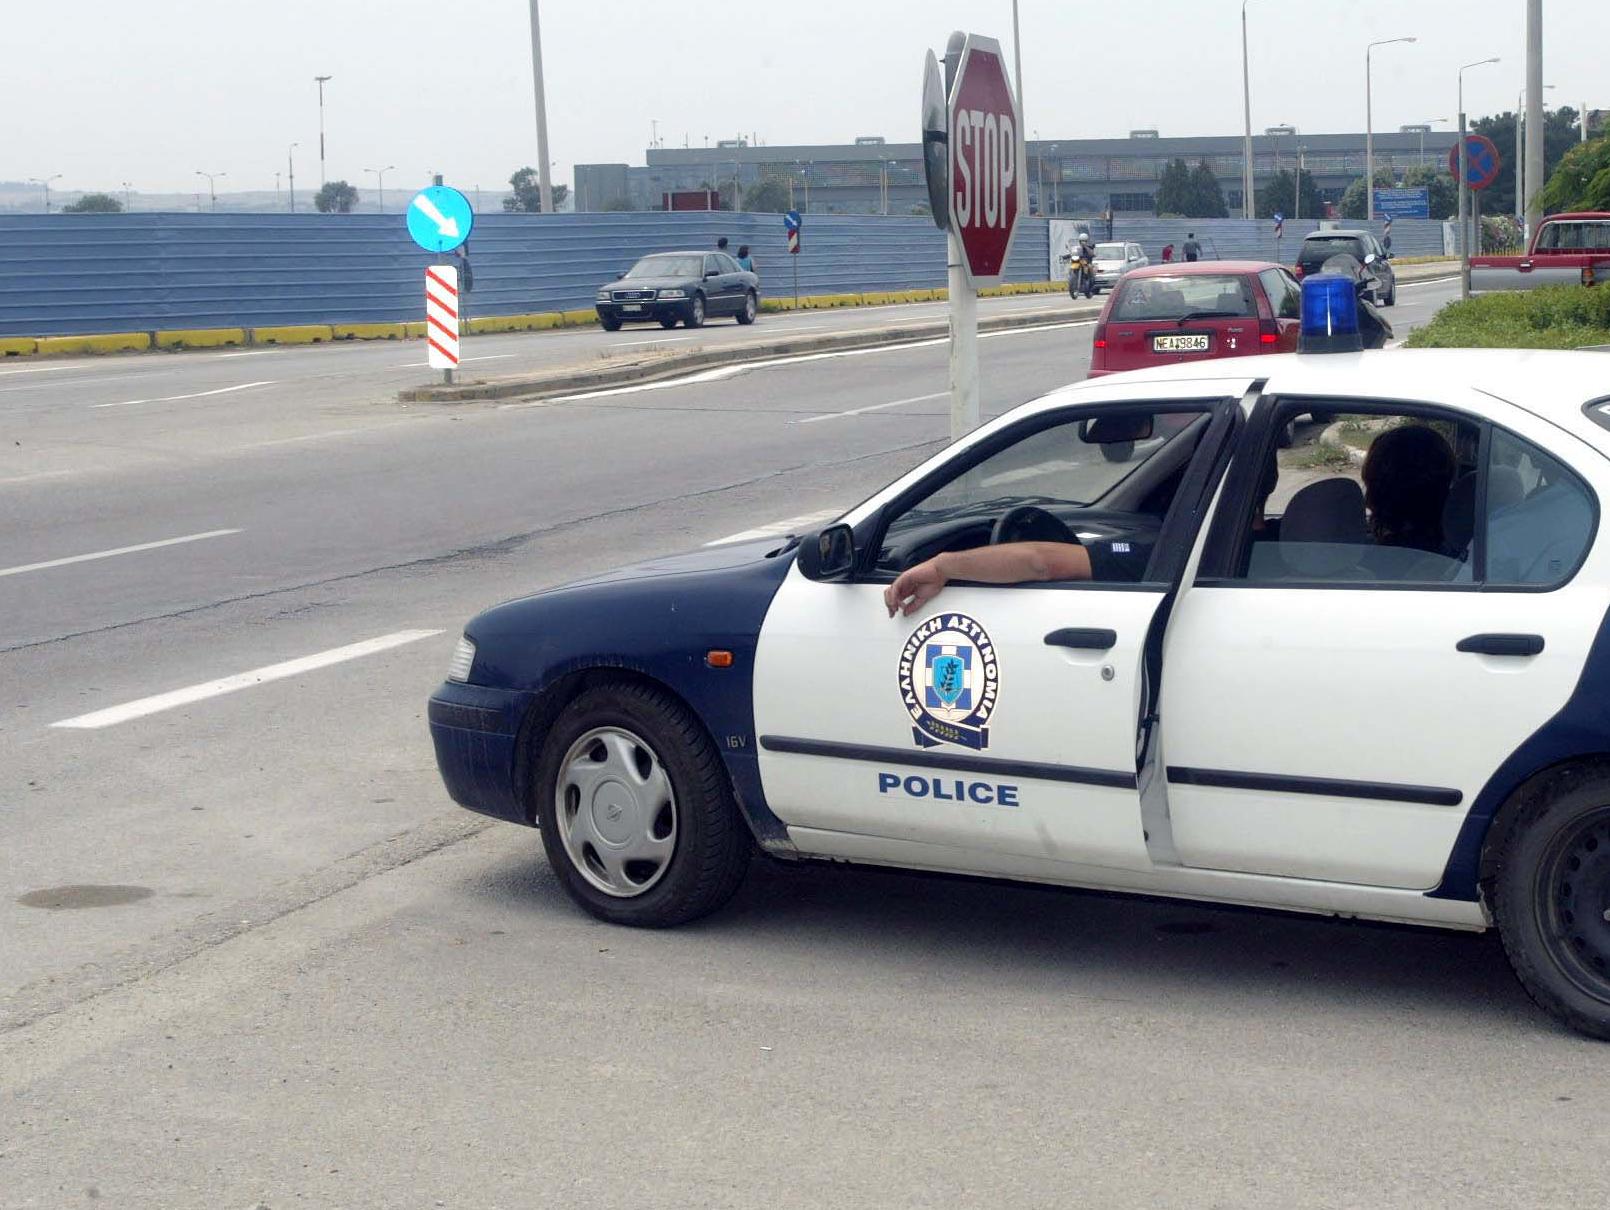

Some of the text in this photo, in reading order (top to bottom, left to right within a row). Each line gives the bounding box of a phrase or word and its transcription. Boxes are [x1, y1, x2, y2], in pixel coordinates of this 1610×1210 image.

[956, 108, 1014, 229] STOP
[900, 615, 998, 720] ΕΛΛΗΝΙΚΗ ΑΣΤΥΝΟΜΙΑ
[726, 735, 747, 749] 16V
[878, 772, 1020, 807] POLICE
